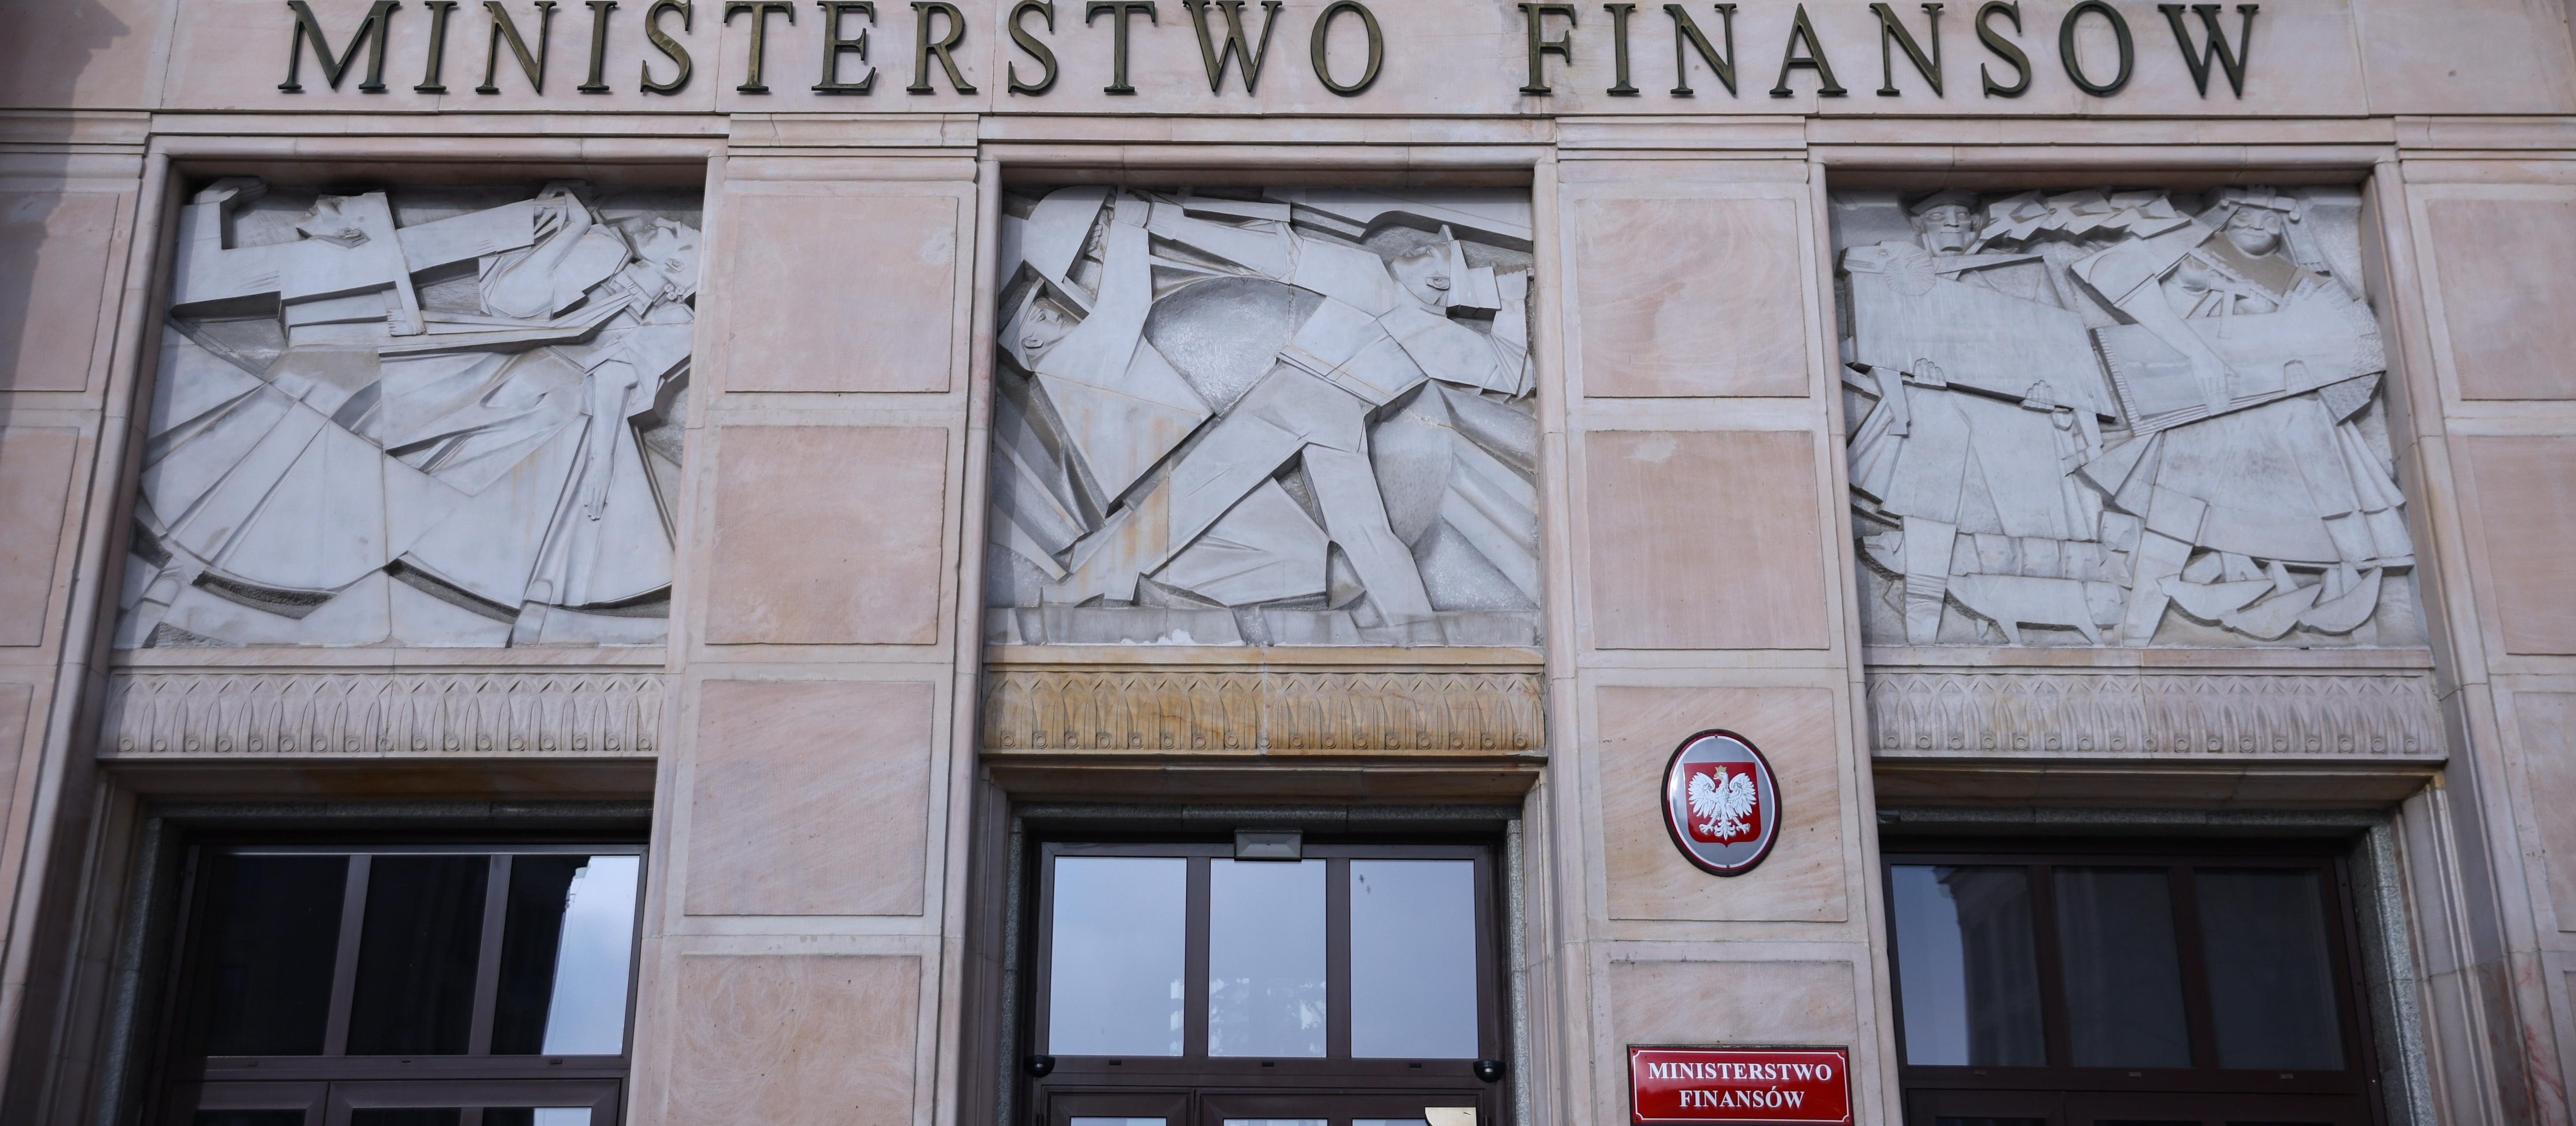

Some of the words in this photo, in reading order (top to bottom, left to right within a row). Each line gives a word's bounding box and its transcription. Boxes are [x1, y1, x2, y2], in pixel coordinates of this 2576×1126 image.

[277, 0, 1385, 98] MINISTERSTWO
[1647, 1062, 1832, 1081] MINISTERSTWO
[1679, 1085, 1805, 1108] FINANSÓW
